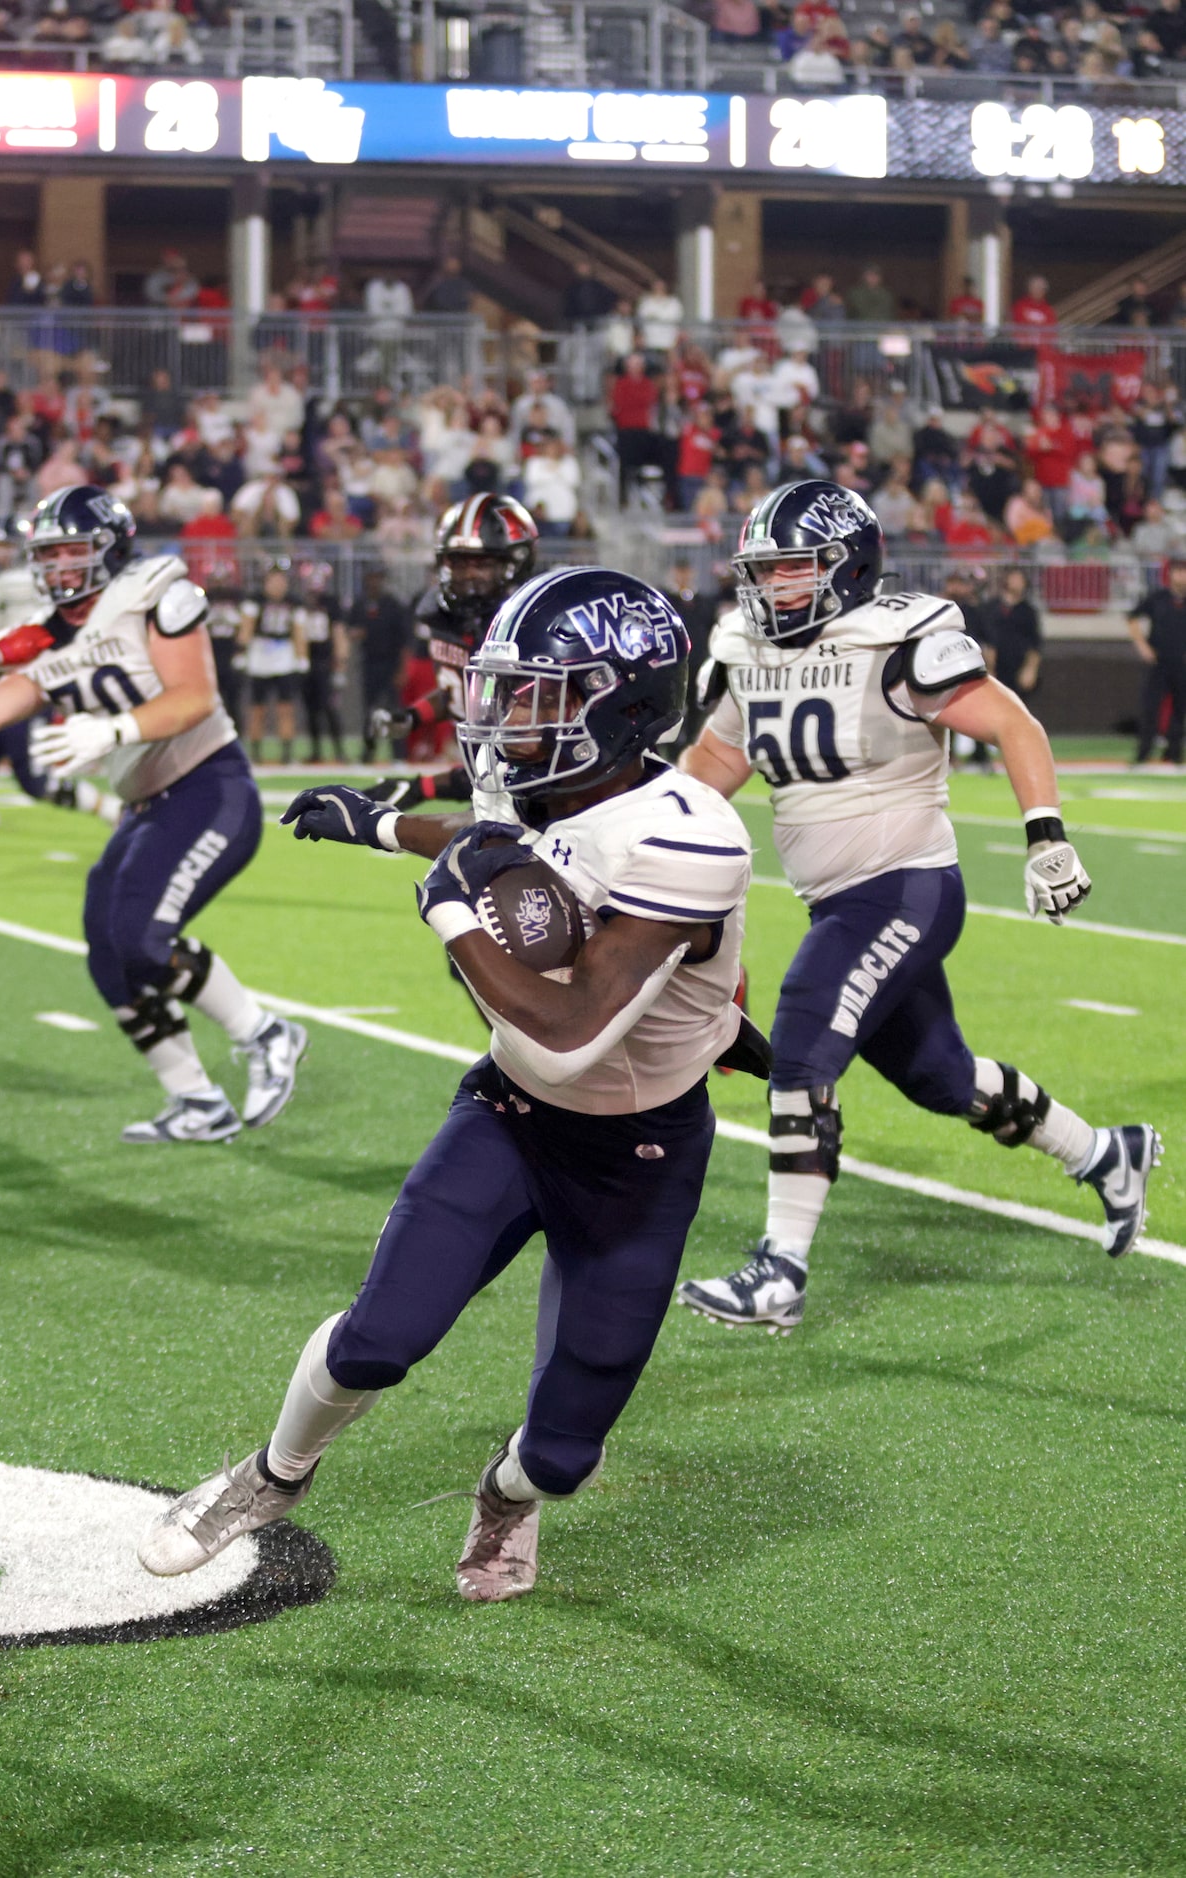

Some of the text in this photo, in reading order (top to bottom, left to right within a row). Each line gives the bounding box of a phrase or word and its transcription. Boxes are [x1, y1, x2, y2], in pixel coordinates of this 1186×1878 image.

[566, 593, 677, 669] WG
[737, 662, 853, 692] WALNUT GROVE
[748, 698, 850, 788] 50
[662, 790, 694, 816] 1
[830, 919, 921, 1039] WILDCATS
